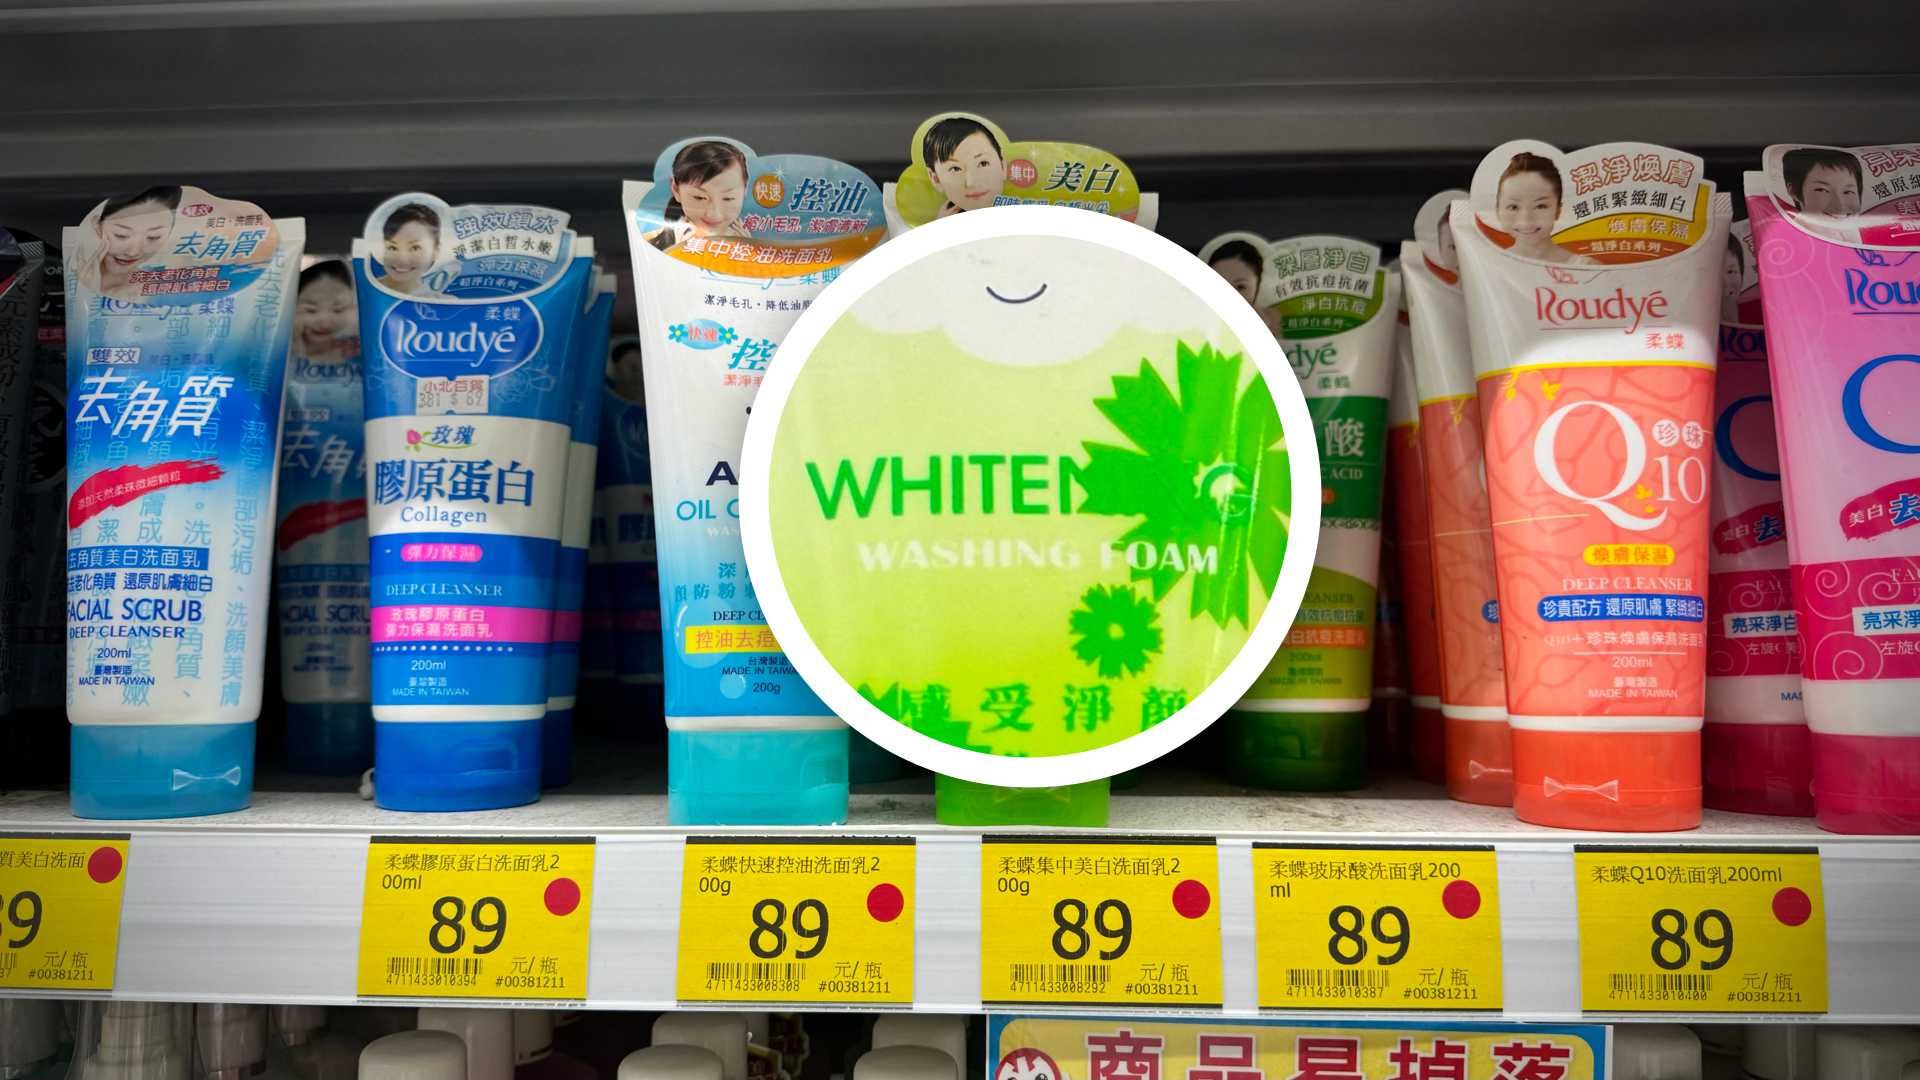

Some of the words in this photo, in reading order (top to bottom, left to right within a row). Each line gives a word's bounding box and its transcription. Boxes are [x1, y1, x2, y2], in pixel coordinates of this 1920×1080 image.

[1861, 149, 1920, 177] 亮采
[1010, 168, 1035, 181] 集中
[1042, 161, 1120, 193] 美白
[1572, 154, 1694, 195] 潔淨煥膚
[756, 181, 781, 202] 快速
[790, 177, 868, 213] 控油
[1574, 190, 1686, 219] 還原緊緻細白
[172, 230, 266, 260] 去角質
[682, 237, 833, 265] 集中控油洗面乳
[1274, 248, 1370, 278] 深層淨白
[1275, 274, 1369, 298] 有效抗痘抗菌
[1845, 269, 1920, 310] Rou
[485, 306, 521, 321] 柔蝶
[1535, 287, 1669, 334] Roudyé
[688, 324, 717, 341] 快速
[1645, 333, 1685, 350] 柔蝶
[397, 319, 516, 368] Roudyé
[91, 349, 136, 363] 雙效
[728, 338, 778, 370] 控
[423, 379, 483, 394] 小北百貨
[75, 368, 234, 443] 去角質
[432, 425, 475, 445] 玫瑰
[1656, 422, 1704, 446] 珍珠
[1332, 469, 1363, 480] ACID
[1534, 401, 1706, 532] Q10
[375, 459, 534, 507] 膠原蛋白
[400, 507, 487, 527] Collagen
[676, 499, 716, 520] OIL
[1849, 504, 1884, 527] 美白
[1889, 494, 1920, 525] 去
[1754, 516, 1784, 542] 去
[857, 538, 1079, 573] WASHING
[1100, 541, 1218, 575] FOAM
[386, 583, 418, 597] DEEP
[420, 583, 502, 597] CLEANSER
[1563, 577, 1608, 591] DEEP
[1613, 577, 1693, 591] CLEANSER
[122, 598, 202, 621] SCRUB
[713, 611, 745, 621] DEEP
[1544, 599, 1601, 617] 珍貴配方
[1606, 598, 1662, 616] 還原肌膚
[70, 626, 94, 639] DEEP
[99, 626, 185, 638] CLEANSER
[97, 648, 132, 659] 200ml
[1612, 656, 1653, 668] 200ml
[411, 660, 446, 671] 200ml
[722, 667, 751, 676] MADE
[754, 667, 764, 676] IN
[768, 667, 798, 676] TAIWA
[79, 676, 99, 686] MADE
[102, 676, 112, 685] IN
[115, 676, 155, 685] TAIWAN
[753, 682, 780, 694] 200g
[392, 688, 416, 696] MADE
[419, 688, 428, 696] IN
[431, 688, 470, 696] TAIWAN
[1588, 689, 1622, 698] MADE
[1626, 689, 1637, 698] IN
[1641, 689, 1678, 698] TAIWAN
[385, 854, 559, 872] 柔蝶膠原蛋白洗面乳2
[703, 856, 880, 874] 柔蝶快速控油洗面乳2
[1000, 856, 1181, 876] 柔蝶集中美白洗面乳2
[1270, 861, 1461, 880] 柔蝶玻尿酸洗面乳200
[382, 874, 422, 890] 00ml
[1592, 866, 1782, 884] 柔蝶Q10洗面乳200ml
[699, 877, 731, 896] 00g
[998, 877, 1030, 896] 00g
[1270, 882, 1291, 898] ml
[0, 890, 42, 949] 9
[429, 896, 507, 954] 89
[749, 899, 829, 959] 89
[1052, 899, 1132, 960] 89
[1328, 905, 1410, 965] 89
[1651, 909, 1733, 970] 89
[72, 952, 88, 968] 瓶
[540, 957, 558, 974] 瓶
[29, 969, 95, 981] #00381211
[864, 962, 882, 978] 瓶
[1172, 964, 1190, 982] 瓶
[1451, 968, 1469, 986] 瓶
[386, 974, 477, 986] 4711433010394
[496, 976, 565, 988] #00381211
[705, 980, 800, 992] 4711433008308
[819, 981, 890, 993] #00381211
[1010, 982, 1106, 993] 4711433008292
[1125, 983, 1198, 995] #00381211
[1775, 973, 1793, 990] 瓶
[1286, 987, 1384, 998] 4711433010387
[1403, 988, 1477, 999] #00381211
[1609, 990, 1707, 1000] 4711433010400
[1728, 992, 1802, 1003] #00381211
